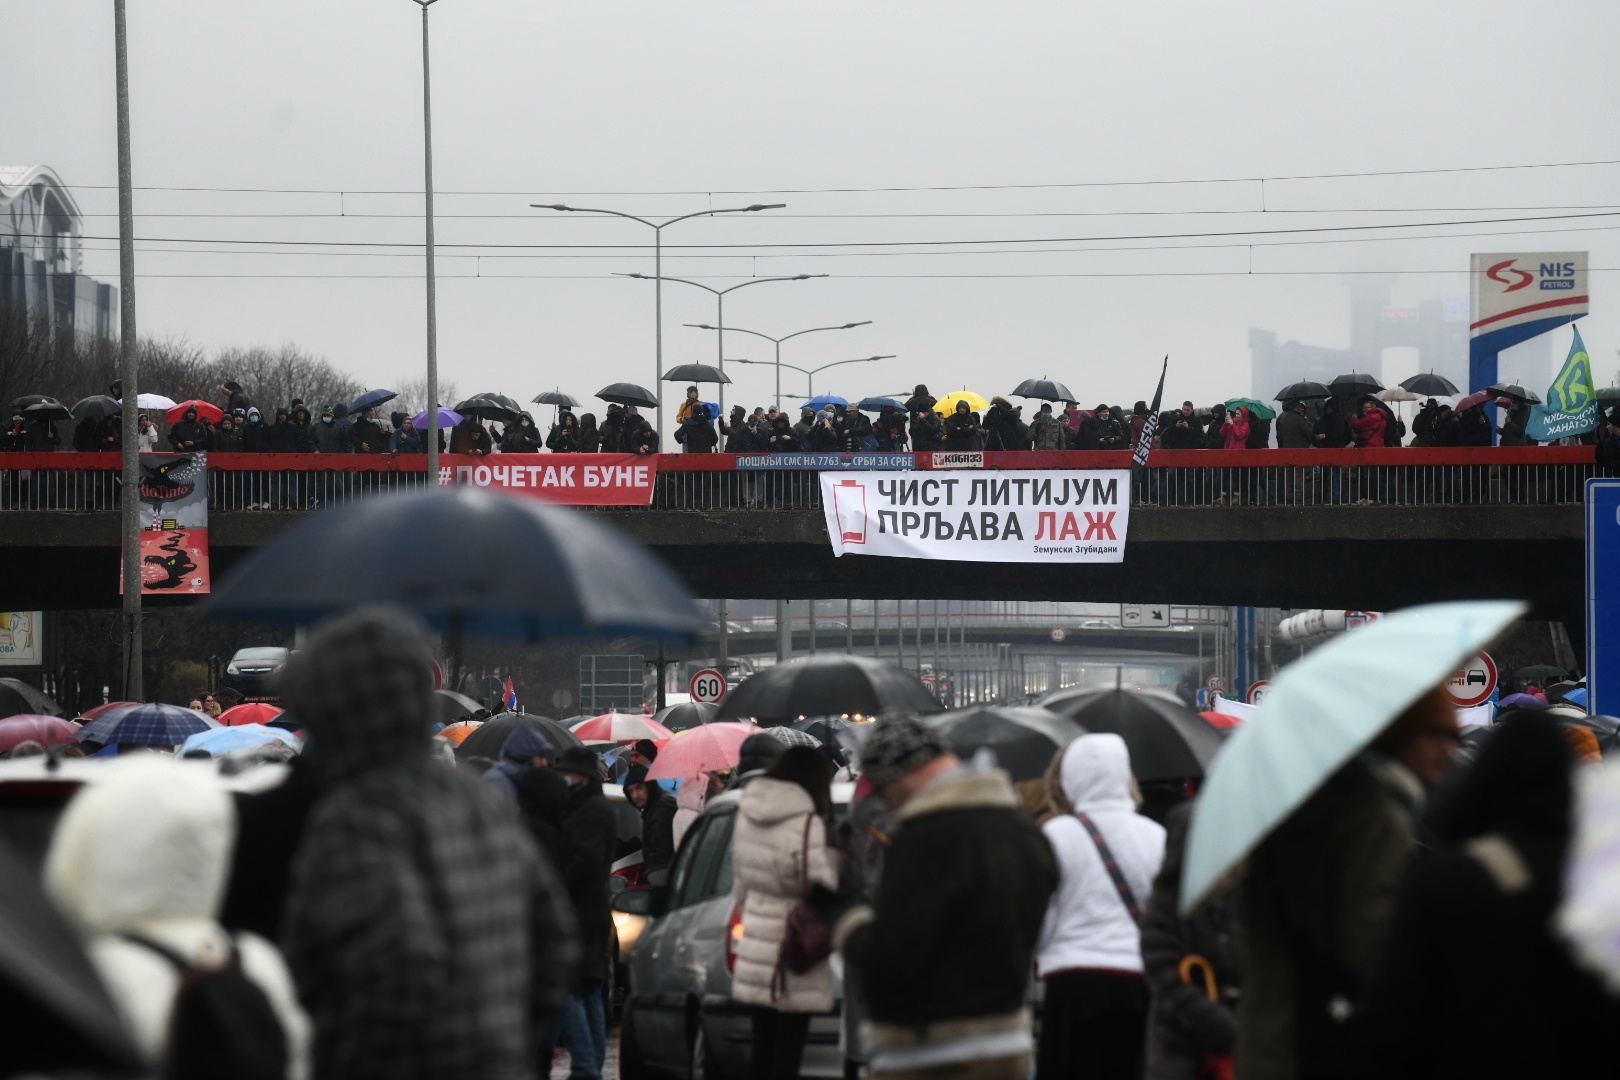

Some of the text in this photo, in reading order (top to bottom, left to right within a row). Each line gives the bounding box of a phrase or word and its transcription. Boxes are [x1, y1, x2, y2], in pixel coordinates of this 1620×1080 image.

[1540, 262, 1575, 277] NIS
[738, 455, 782, 467] ПОШАЉИ
[783, 456, 802, 466] СМС
[803, 456, 816, 466] НА
[818, 456, 839, 467] 7763
[852, 456, 876, 467] СРБИ
[877, 456, 889, 467] ЗА
[890, 456, 913, 468] СРБЕ
[583, 465, 649, 488] БУНЕ
[157, 485, 189, 499] Tinto
[877, 477, 1118, 506] ЧИСТ ЛИТИЈУМ
[877, 509, 1118, 541] ПРЉАВА ЛАЖ
[1033, 544, 1118, 555] Земунски Згубидани
[697, 678, 719, 697] 60
[1210, 679, 1222, 689] 60
